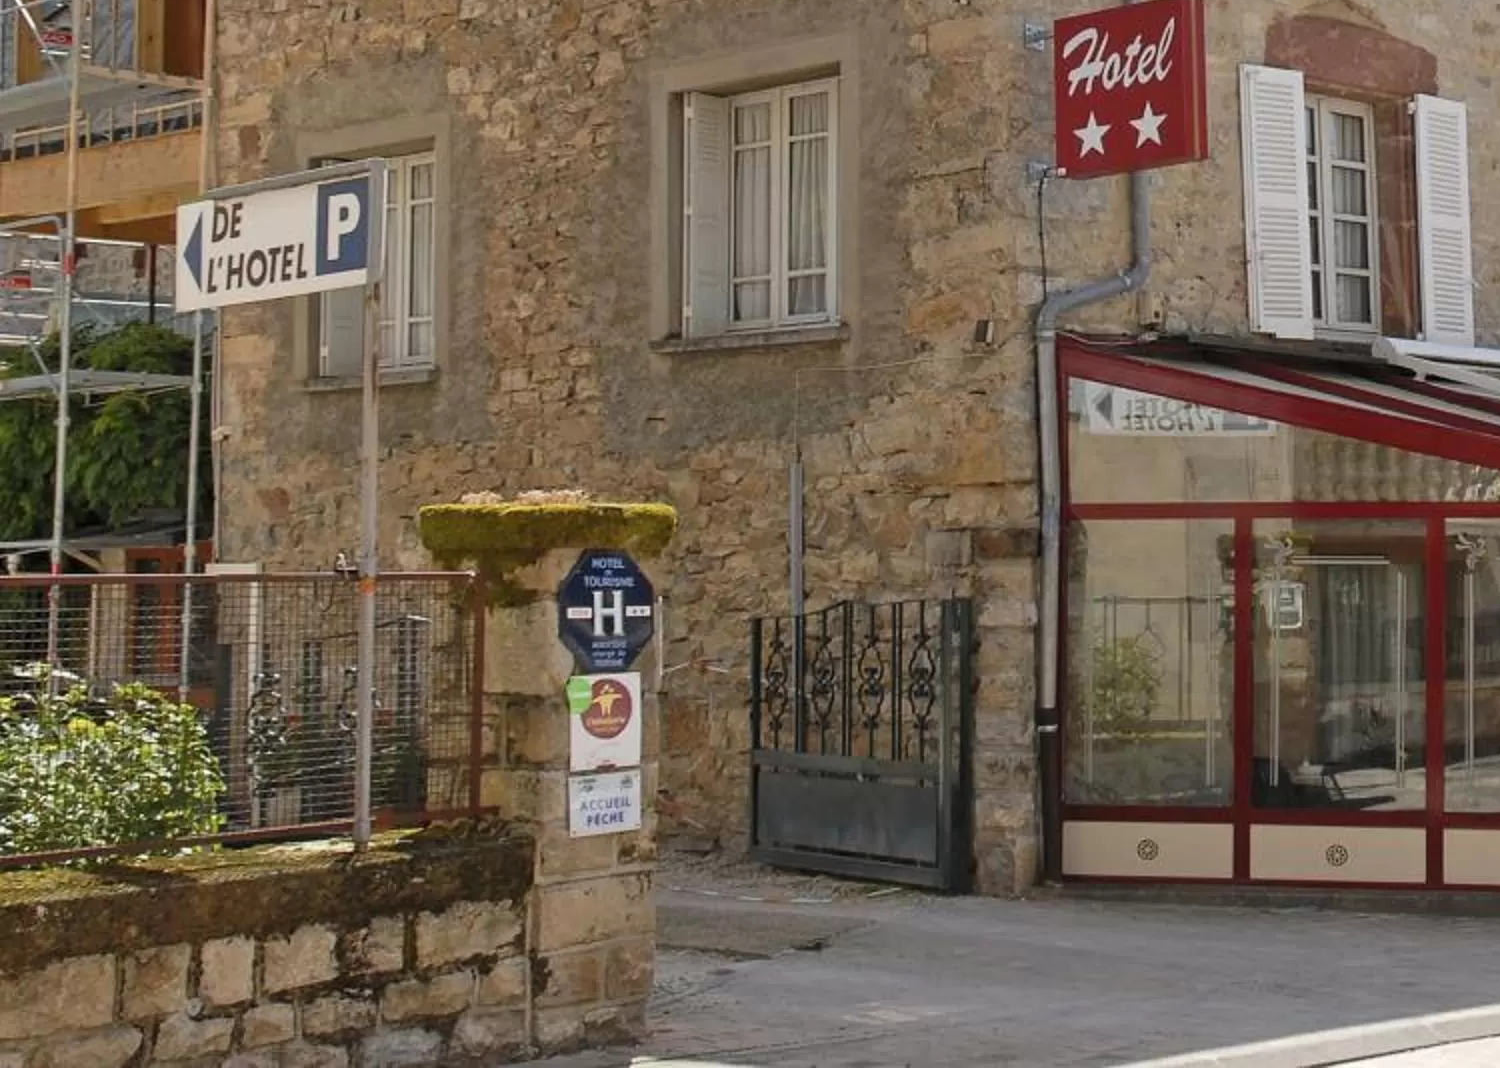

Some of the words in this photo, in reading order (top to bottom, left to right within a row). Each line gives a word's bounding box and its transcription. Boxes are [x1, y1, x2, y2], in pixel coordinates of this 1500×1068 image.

[1063, 16, 1176, 97] Hotel
[211, 202, 243, 244] DE
[326, 193, 361, 261] P
[206, 242, 307, 293] L'HOTEL
[592, 590, 625, 637] H
[580, 795, 631, 812] ACCUEIL
